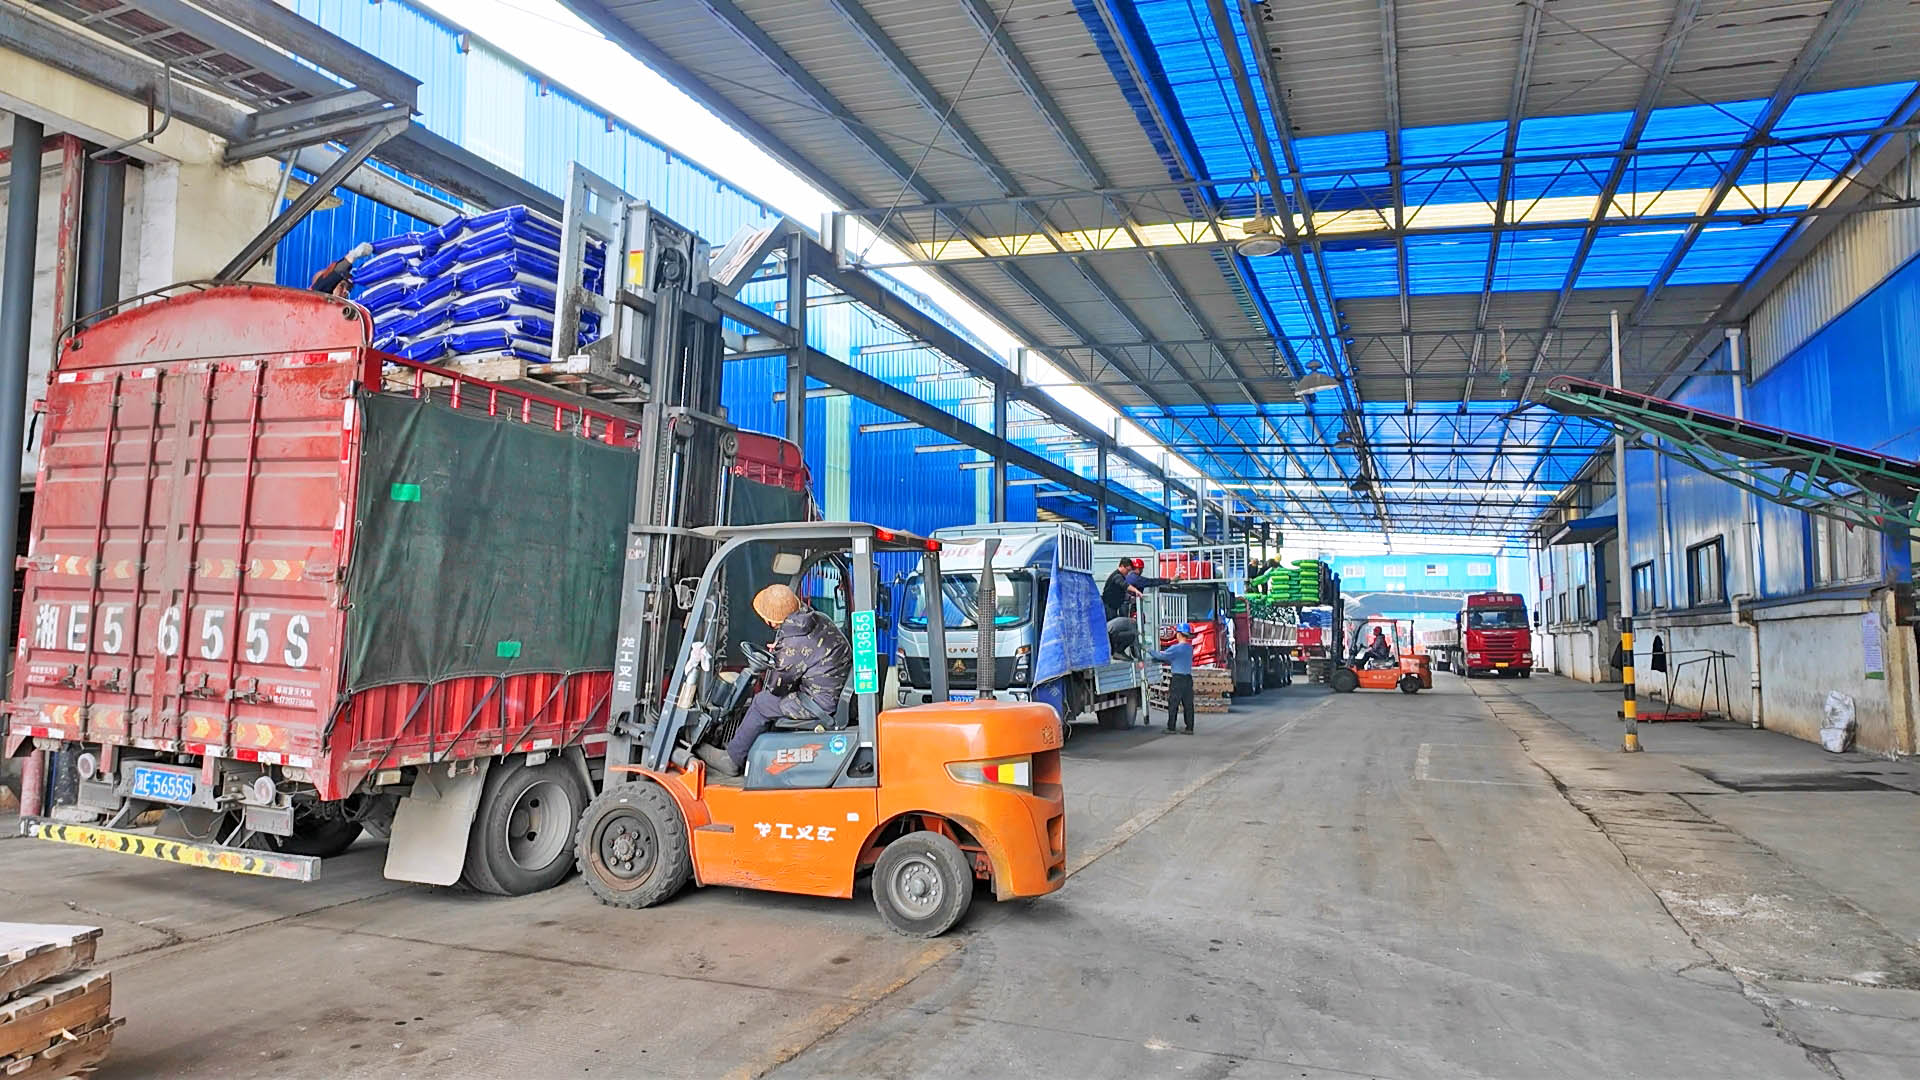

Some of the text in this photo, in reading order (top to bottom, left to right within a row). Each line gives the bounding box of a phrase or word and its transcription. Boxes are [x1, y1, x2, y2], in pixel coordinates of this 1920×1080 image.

[617, 636, 635, 692] 龙工叉车
[753, 821, 836, 842] 龙工叉车
